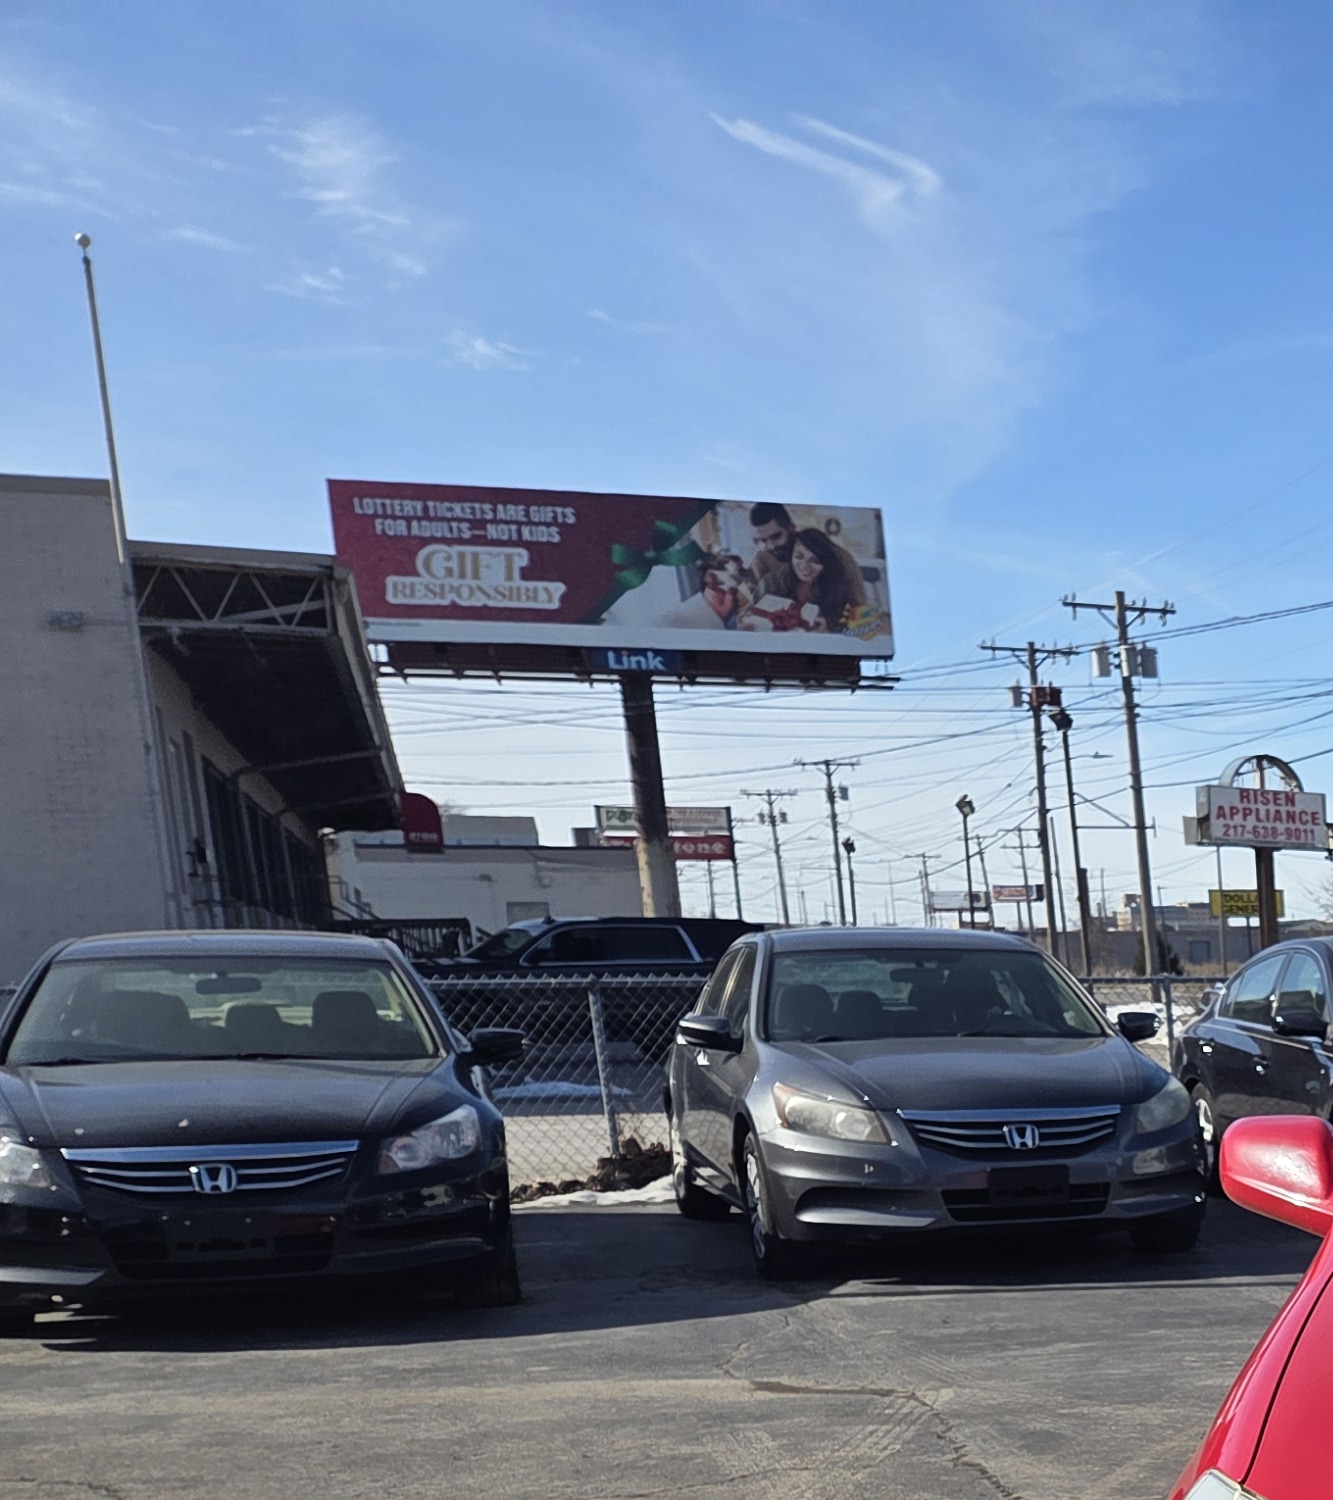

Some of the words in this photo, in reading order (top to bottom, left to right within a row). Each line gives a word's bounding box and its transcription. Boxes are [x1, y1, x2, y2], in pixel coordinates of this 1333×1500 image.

[353, 496, 425, 516] LOTTERY
[426, 501, 495, 520] TICKETS
[496, 504, 528, 522] ARE
[529, 505, 577, 524] GIFTS
[374, 518, 408, 536] FOR
[521, 524, 561, 543] KIDS
[421, 548, 526, 582] GIFT
[391, 580, 562, 604] RESPONSIBLY
[607, 650, 667, 671] Link
[1239, 790, 1296, 807] RISEN
[1216, 805, 1320, 826] APPLIANCE
[1223, 893, 1258, 904] DOLL
